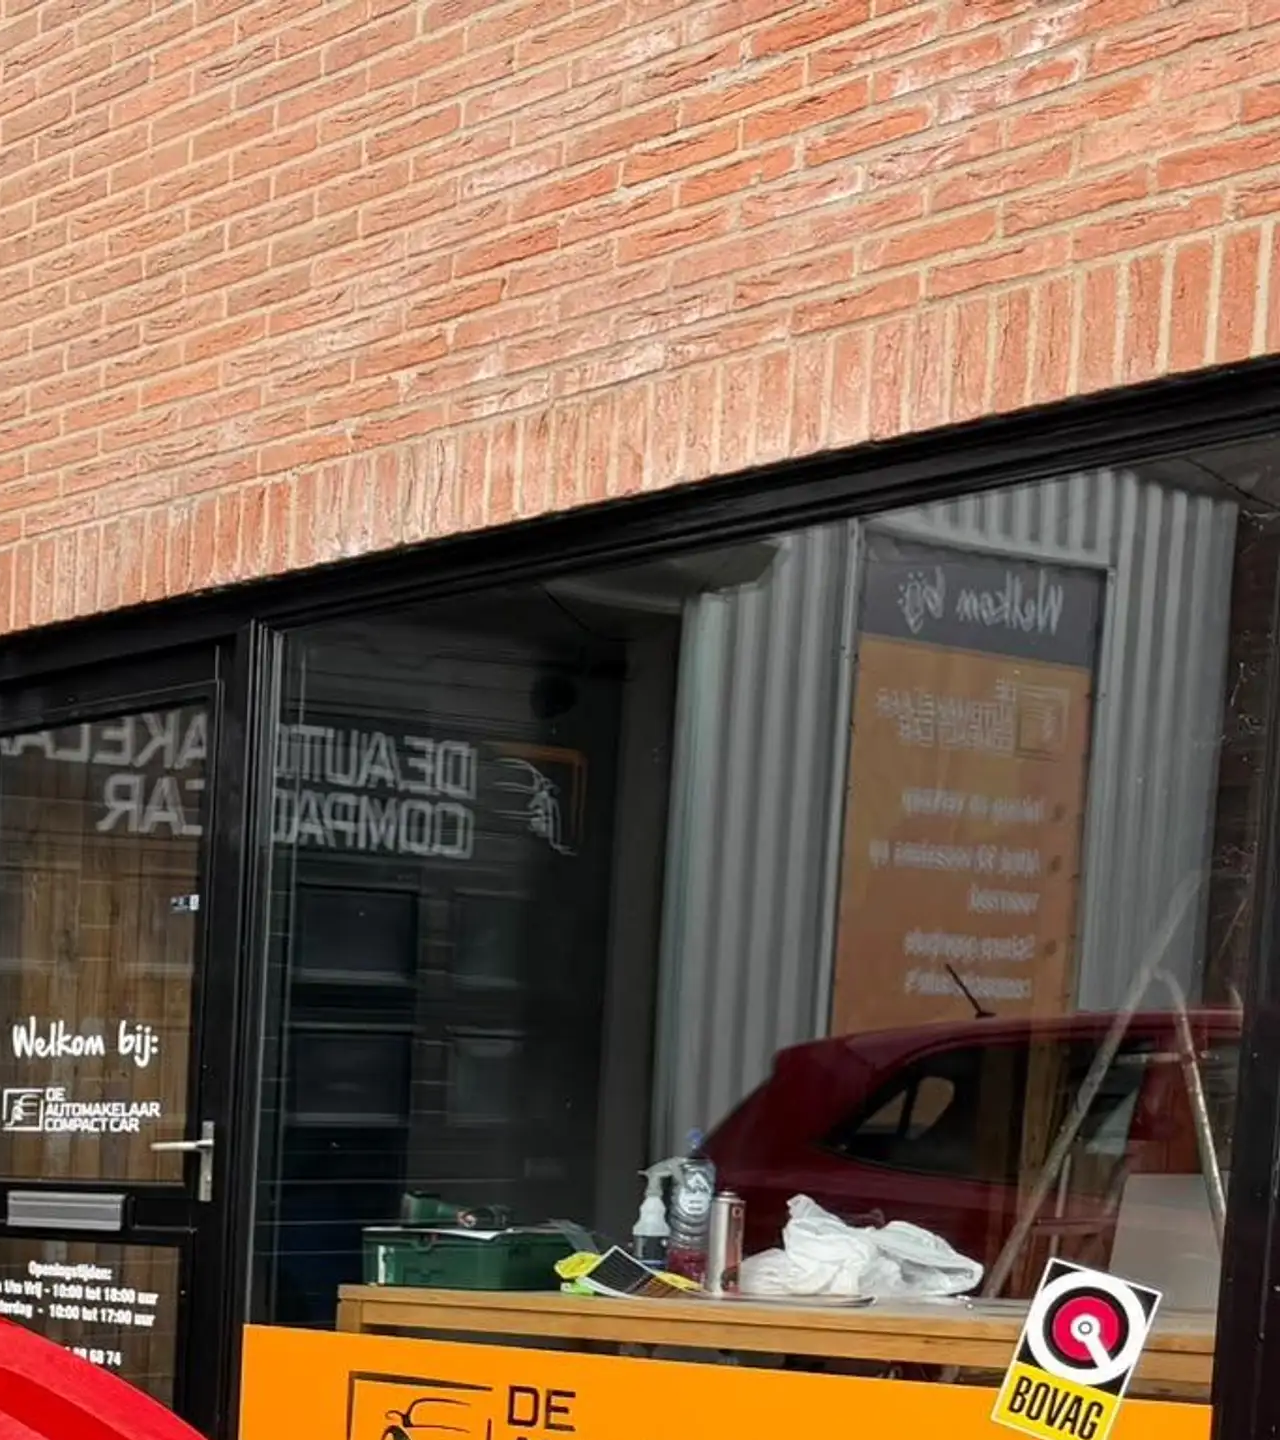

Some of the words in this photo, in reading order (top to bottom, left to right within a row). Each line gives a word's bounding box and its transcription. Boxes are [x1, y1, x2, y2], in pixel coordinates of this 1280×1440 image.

[12, 1015, 105, 1059] Welkom
[118, 1019, 159, 1068] bij:
[44, 1087, 67, 1102] DE
[44, 1101, 162, 1118] AUTOMAKELAAR
[44, 1117, 108, 1133] COMPACT
[109, 1118, 141, 1133] CAR
[84, 1285, 102, 1301] tot
[103, 1286, 136, 1305] 18:00
[137, 1290, 160, 1306] uur
[81, 1304, 98, 1322] tot
[100, 1306, 133, 1326] 17:00
[133, 1311, 157, 1328] uur
[106, 1350, 122, 1367] 74
[505, 1385, 577, 1432] DE
[1007, 1376, 1105, 1440] BOVAG
